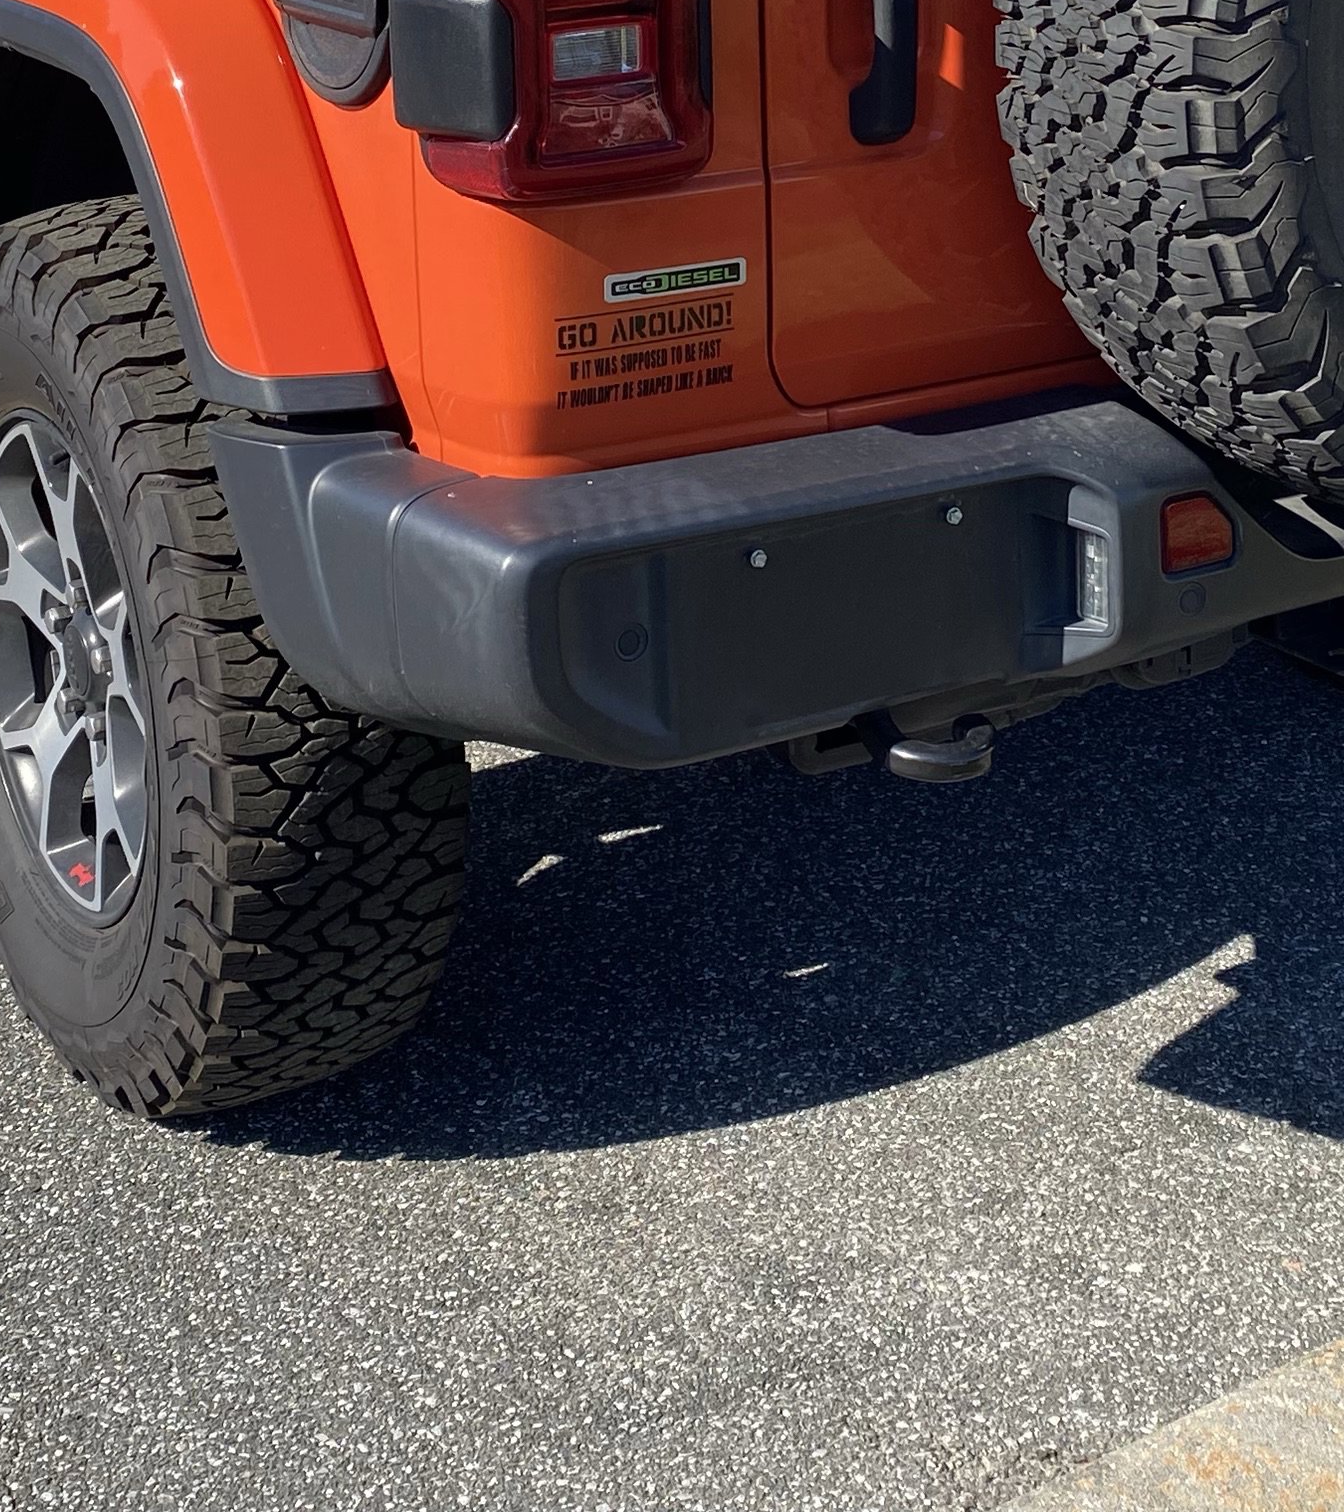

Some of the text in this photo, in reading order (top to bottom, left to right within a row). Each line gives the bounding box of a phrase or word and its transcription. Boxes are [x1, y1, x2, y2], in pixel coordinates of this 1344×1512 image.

[557, 300, 733, 351] GO AROUND!
[570, 337, 722, 381] IF IT WAS SUPPOSED TO BE FAST
[557, 363, 734, 410] IT WOULDN'T BE SHAPED LIKE A BRICK
